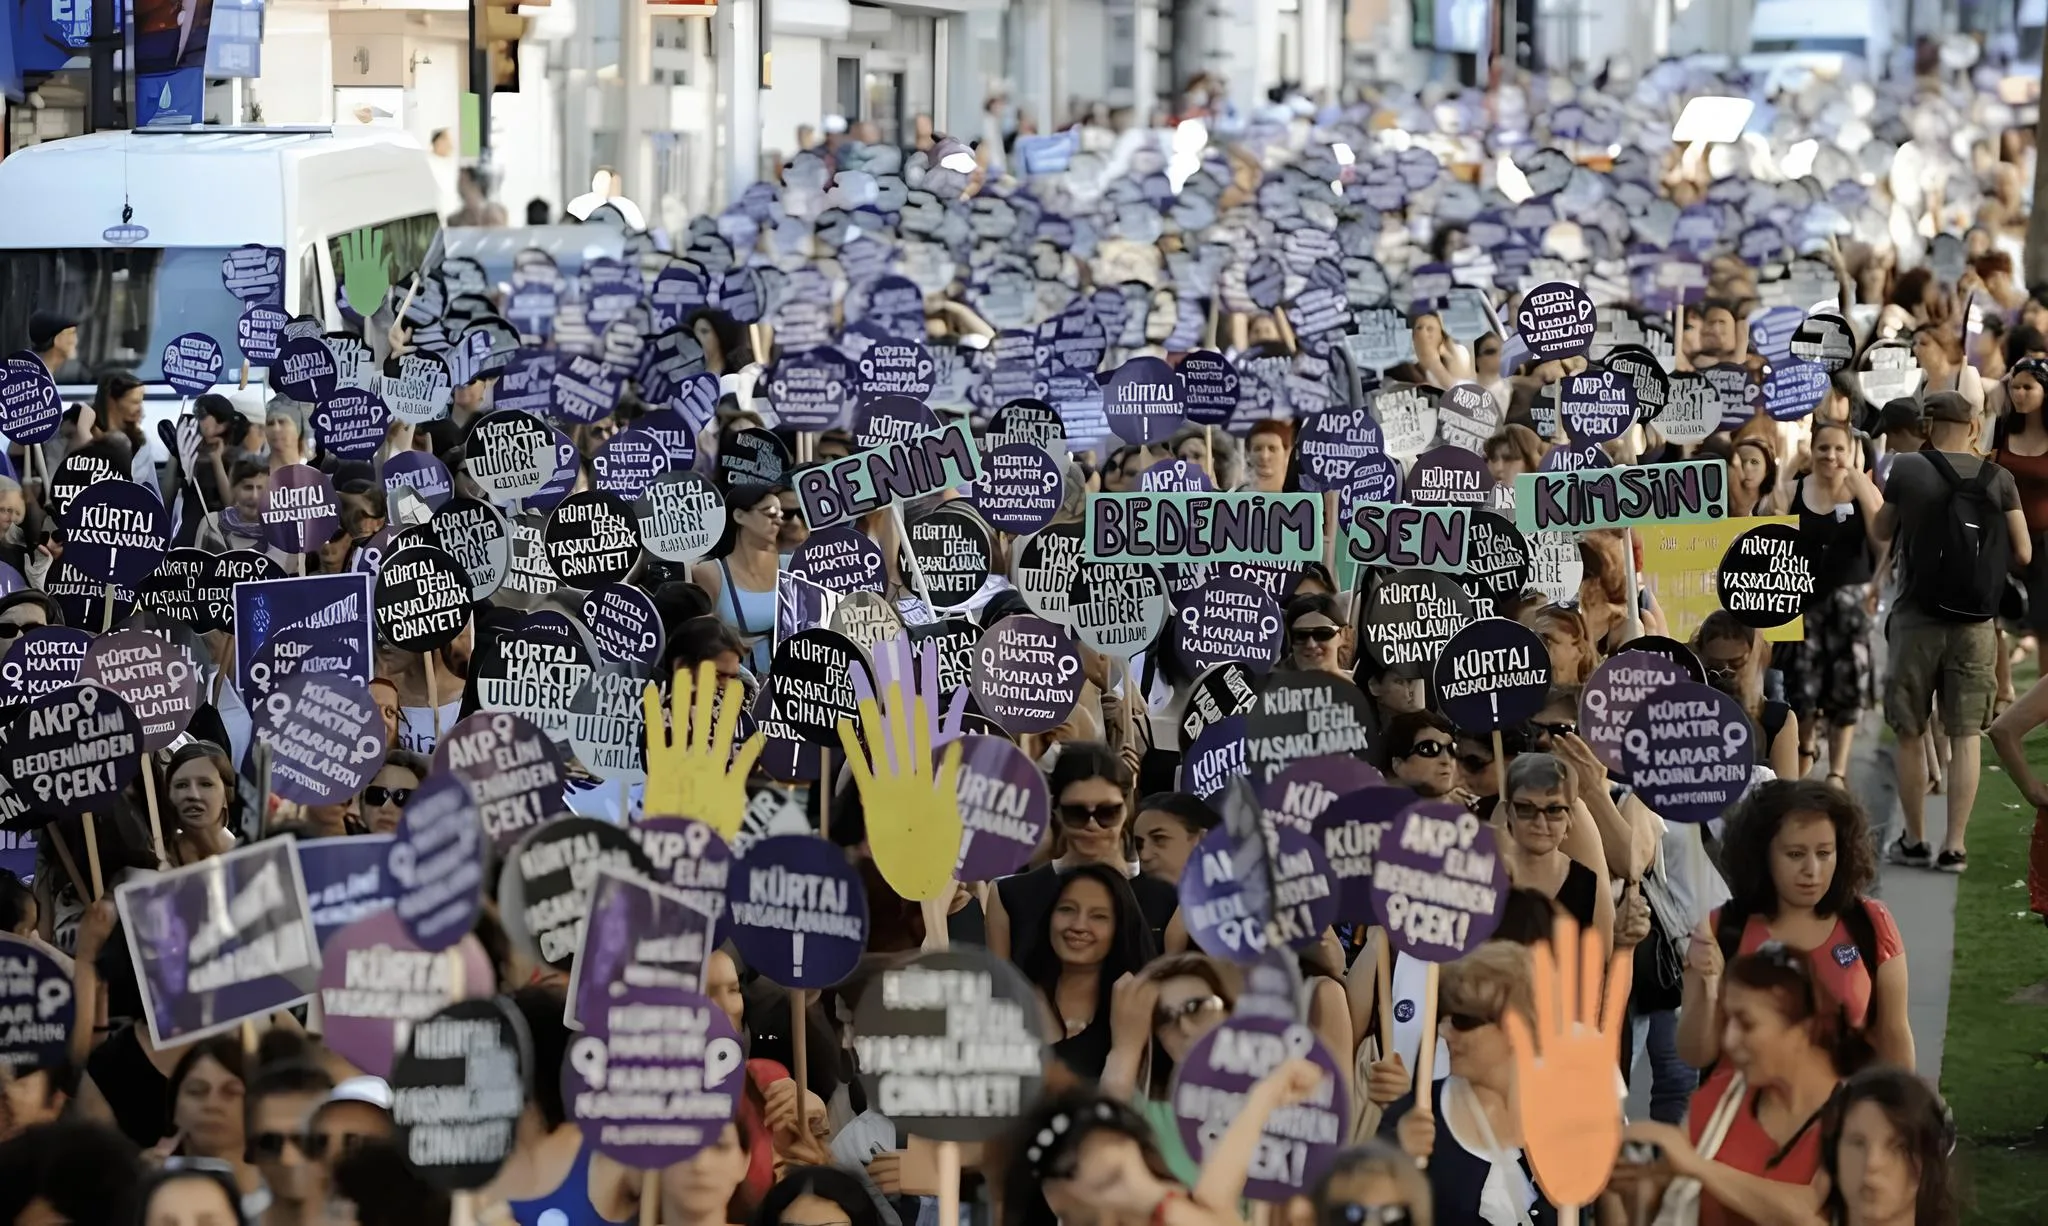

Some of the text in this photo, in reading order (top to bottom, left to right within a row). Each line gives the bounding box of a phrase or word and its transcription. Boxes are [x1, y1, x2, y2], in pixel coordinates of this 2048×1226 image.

[1037, 533, 1085, 553] KÜRT
[1350, 506, 1465, 566] SEN
[592, 672, 645, 695] KÜRT
[1609, 668, 1675, 686] KÜRTAJ
[595, 694, 645, 721] HAK
[1264, 686, 1332, 715] KÜRTAJ
[1490, 693, 1499, 722] !
[1649, 700, 1720, 721] KÜRTAJ
[29, 702, 81, 739] AKP
[1650, 720, 1720, 740] HAKTIR
[449, 731, 497, 771] AKP
[1654, 746, 1720, 766] KARAR
[55, 761, 117, 806] ÇEK!
[1633, 764, 1746, 788] KADINLARIN
[957, 764, 1030, 819] ÜRTAJ
[629, 828, 684, 870] KP
[1401, 813, 1458, 857] AKP
[749, 866, 847, 911] KÜRTAJ
[792, 932, 803, 978] !
